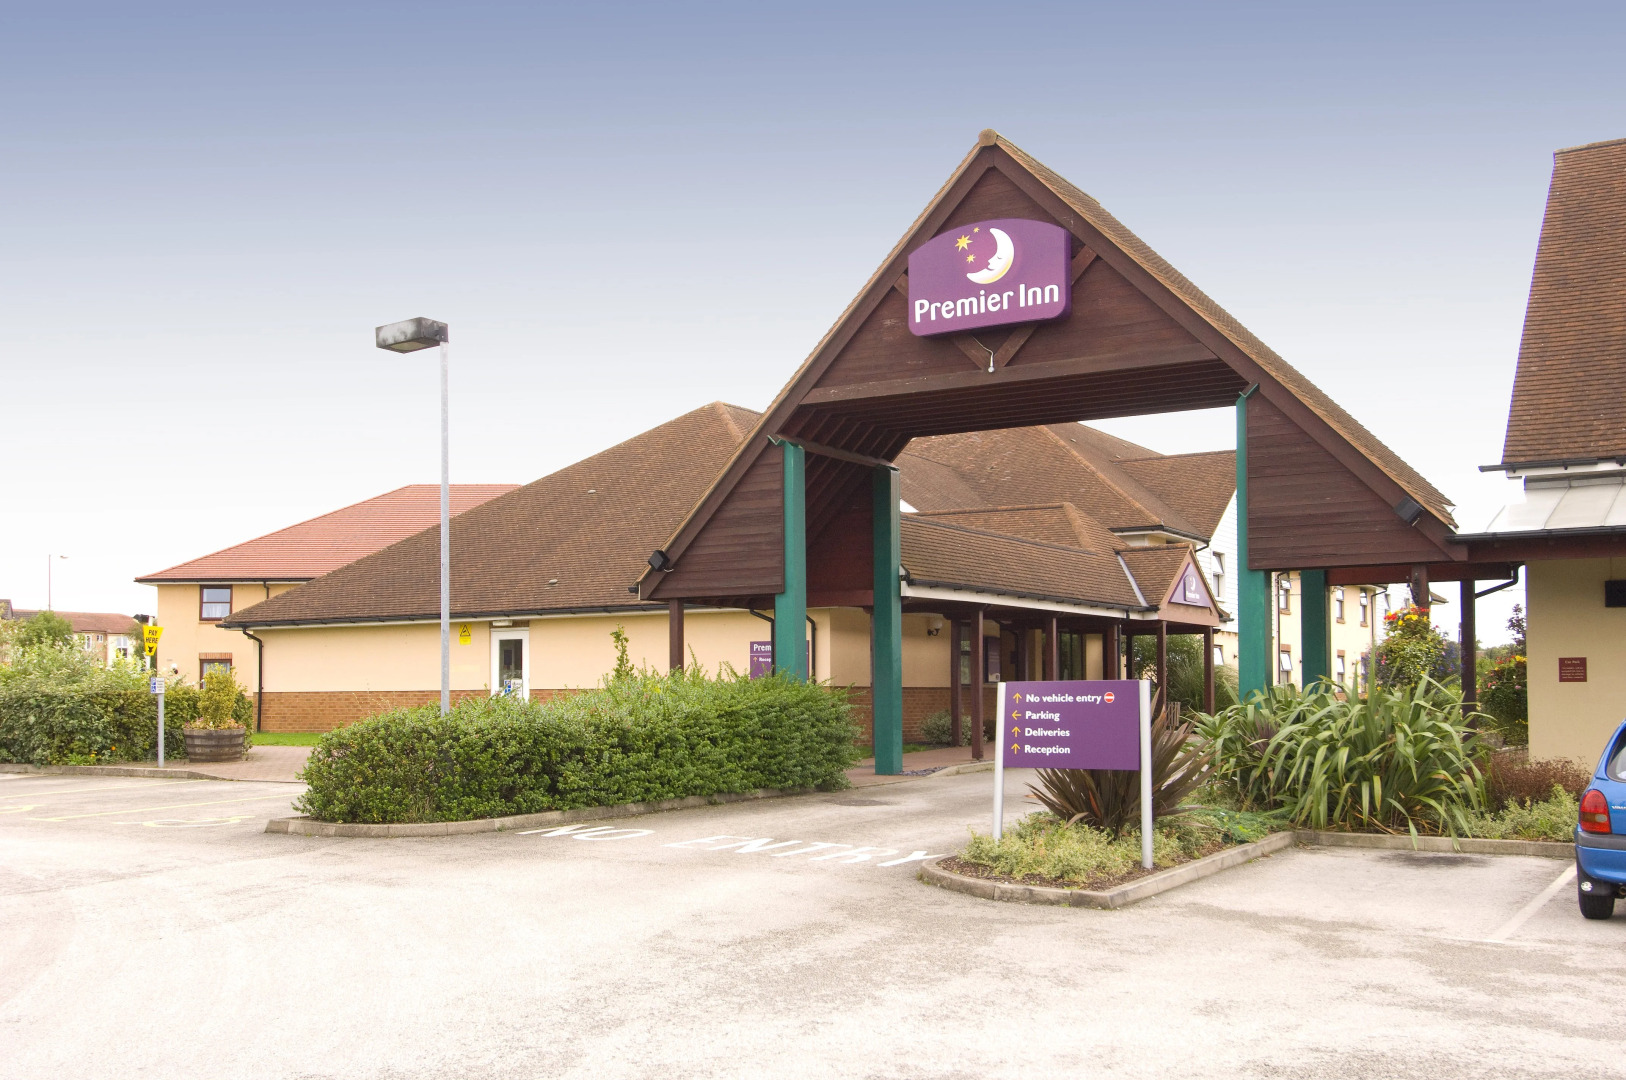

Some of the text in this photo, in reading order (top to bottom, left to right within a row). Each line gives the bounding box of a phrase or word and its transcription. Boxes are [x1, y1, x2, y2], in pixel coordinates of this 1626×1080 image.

[914, 283, 1059, 323] Premier Inn
[1025, 694, 1102, 705] No vehicle entry
[1025, 711, 1060, 722] Parking
[1024, 728, 1070, 737] Deliveries
[1024, 745, 1070, 756] Reception
[514, 823, 946, 867] NO ENTRY
